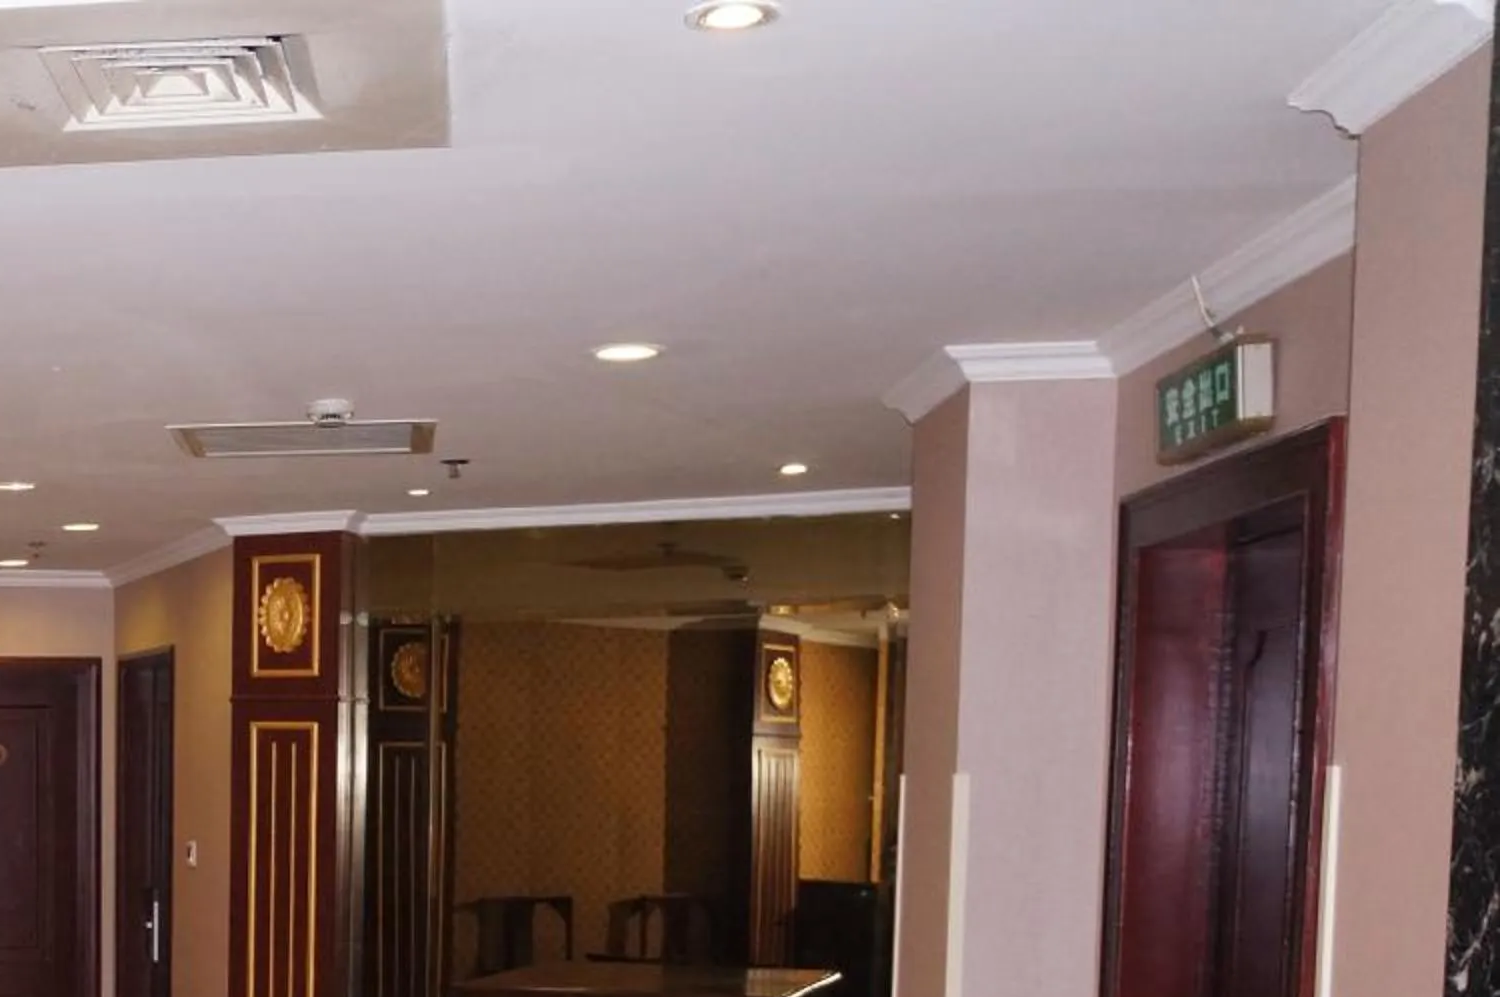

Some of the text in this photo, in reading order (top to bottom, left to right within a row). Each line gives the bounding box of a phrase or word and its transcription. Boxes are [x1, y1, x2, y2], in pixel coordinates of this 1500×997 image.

[1165, 362, 1230, 427] 安全出口
[1174, 409, 1219, 446] EXIT
